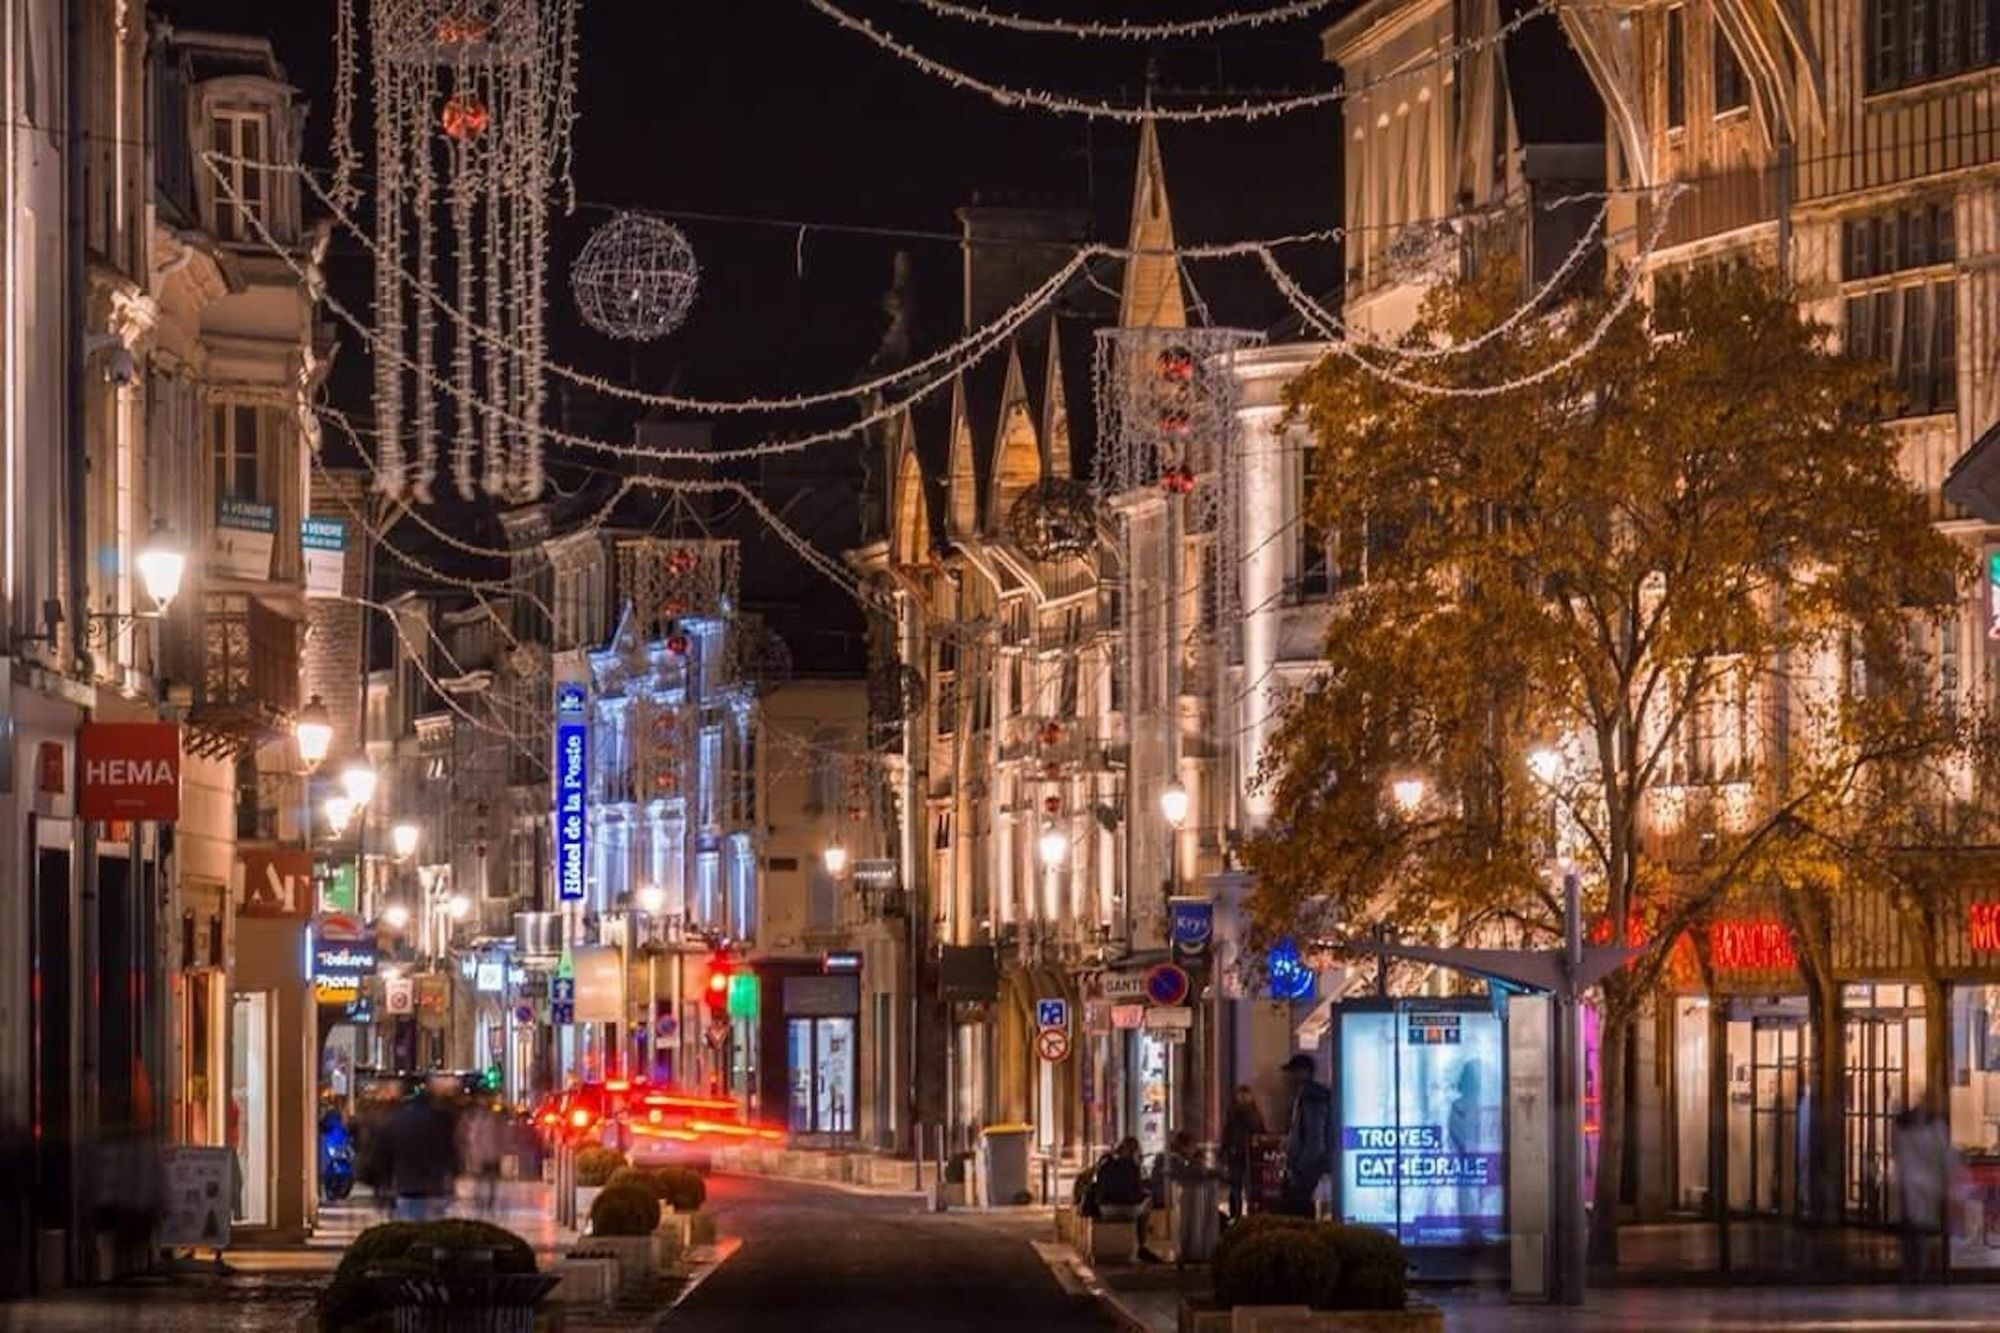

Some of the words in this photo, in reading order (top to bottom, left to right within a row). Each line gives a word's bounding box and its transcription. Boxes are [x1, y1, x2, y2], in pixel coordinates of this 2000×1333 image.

[86, 759, 175, 786] HEMA
[563, 735, 582, 789] Poste
[564, 793, 581, 812] la
[564, 816, 581, 840] de
[563, 843, 582, 895] Hôtel
[1176, 916, 1208, 932] Krys
[1358, 1129, 1440, 1148] TROYES,
[1359, 1155, 1488, 1176] CATHÉDRALE
